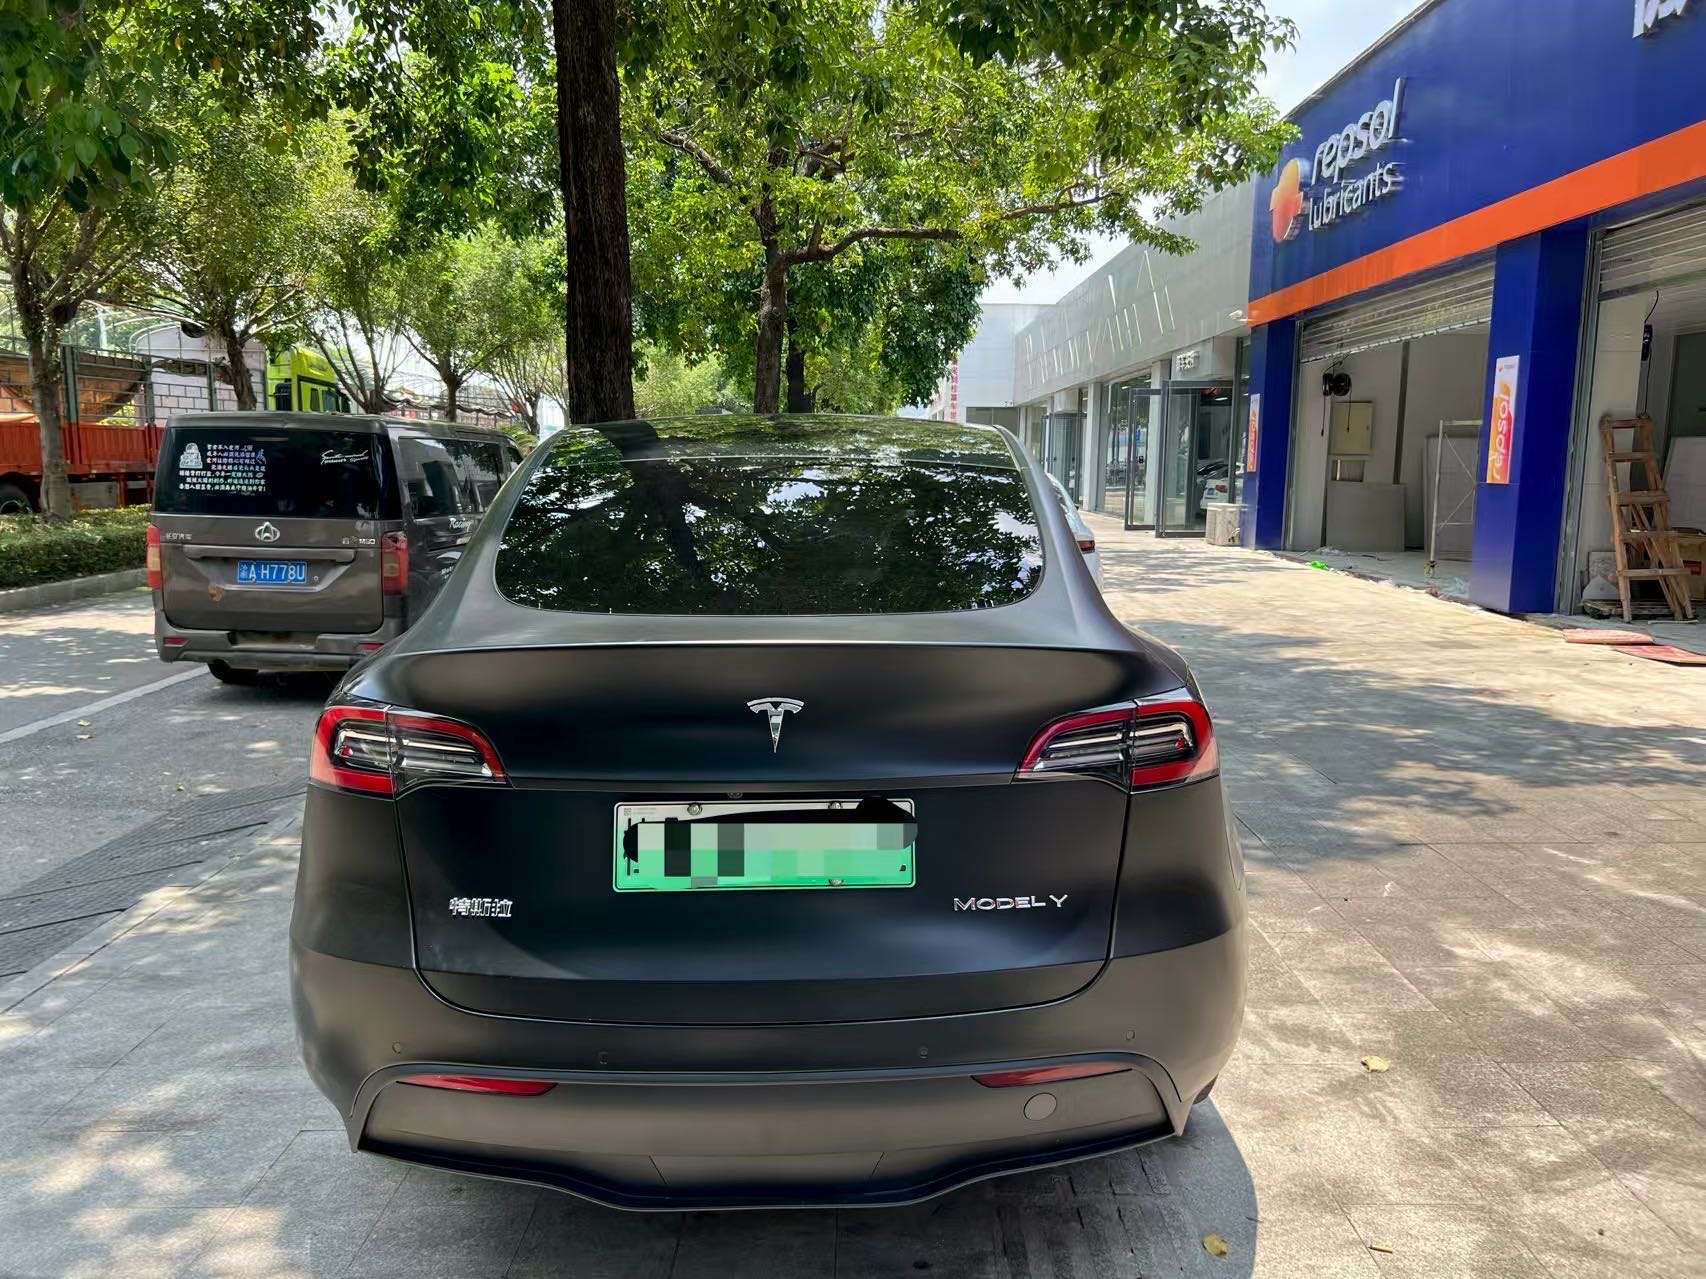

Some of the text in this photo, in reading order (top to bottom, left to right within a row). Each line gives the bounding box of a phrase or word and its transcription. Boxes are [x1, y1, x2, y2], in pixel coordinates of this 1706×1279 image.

[1312, 77, 1407, 186] repsol
[1308, 161, 1398, 231] lubricants
[1492, 394, 1510, 480] repsol
[449, 897, 513, 917] 特斯拉
[953, 894, 1068, 911] MODEL Y
